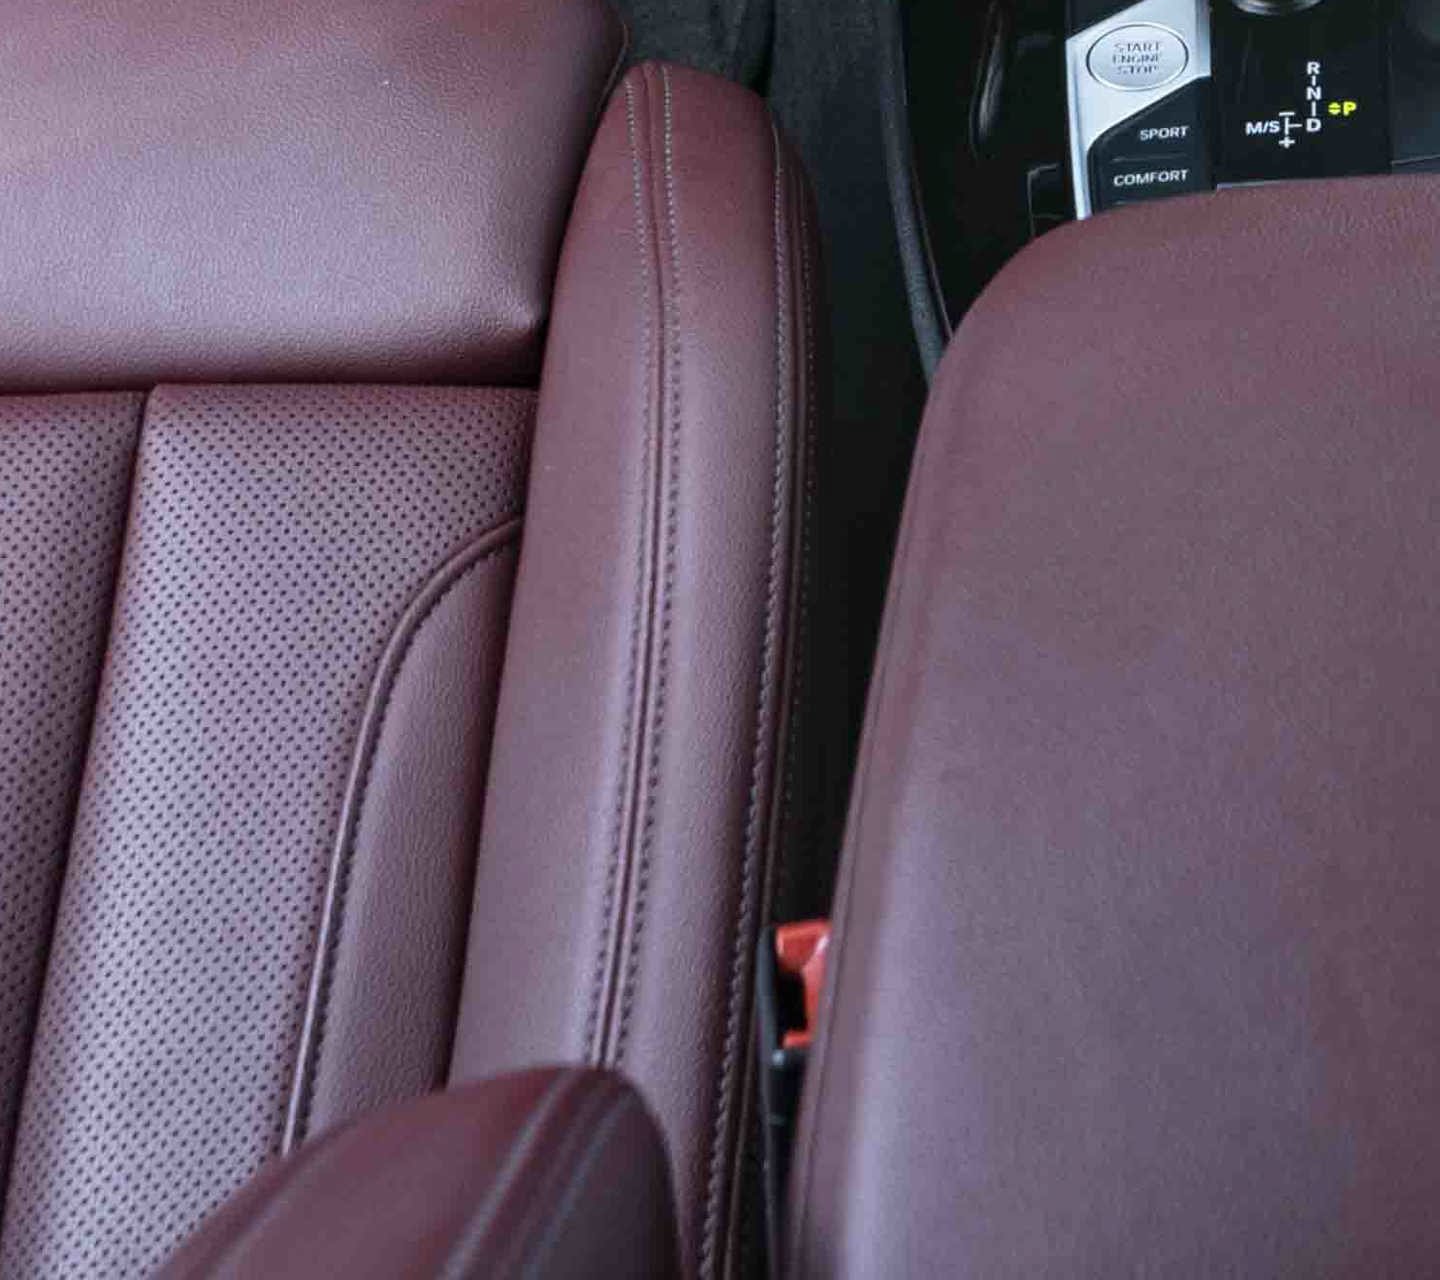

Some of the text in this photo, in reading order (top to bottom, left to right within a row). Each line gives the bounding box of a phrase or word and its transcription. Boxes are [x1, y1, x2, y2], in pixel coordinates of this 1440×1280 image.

[1114, 42, 1160, 53] START
[1113, 53, 1161, 64] ENGINE
[1116, 64, 1160, 75] STOP
[1307, 61, 1320, 74] R
[1306, 86, 1321, 100] N
[1343, 101, 1357, 116] P
[1245, 120, 1280, 135] M/S
[1306, 118, 1321, 132] D
[1140, 125, 1189, 140] SPORT
[1113, 170, 1189, 187] COMFORT
